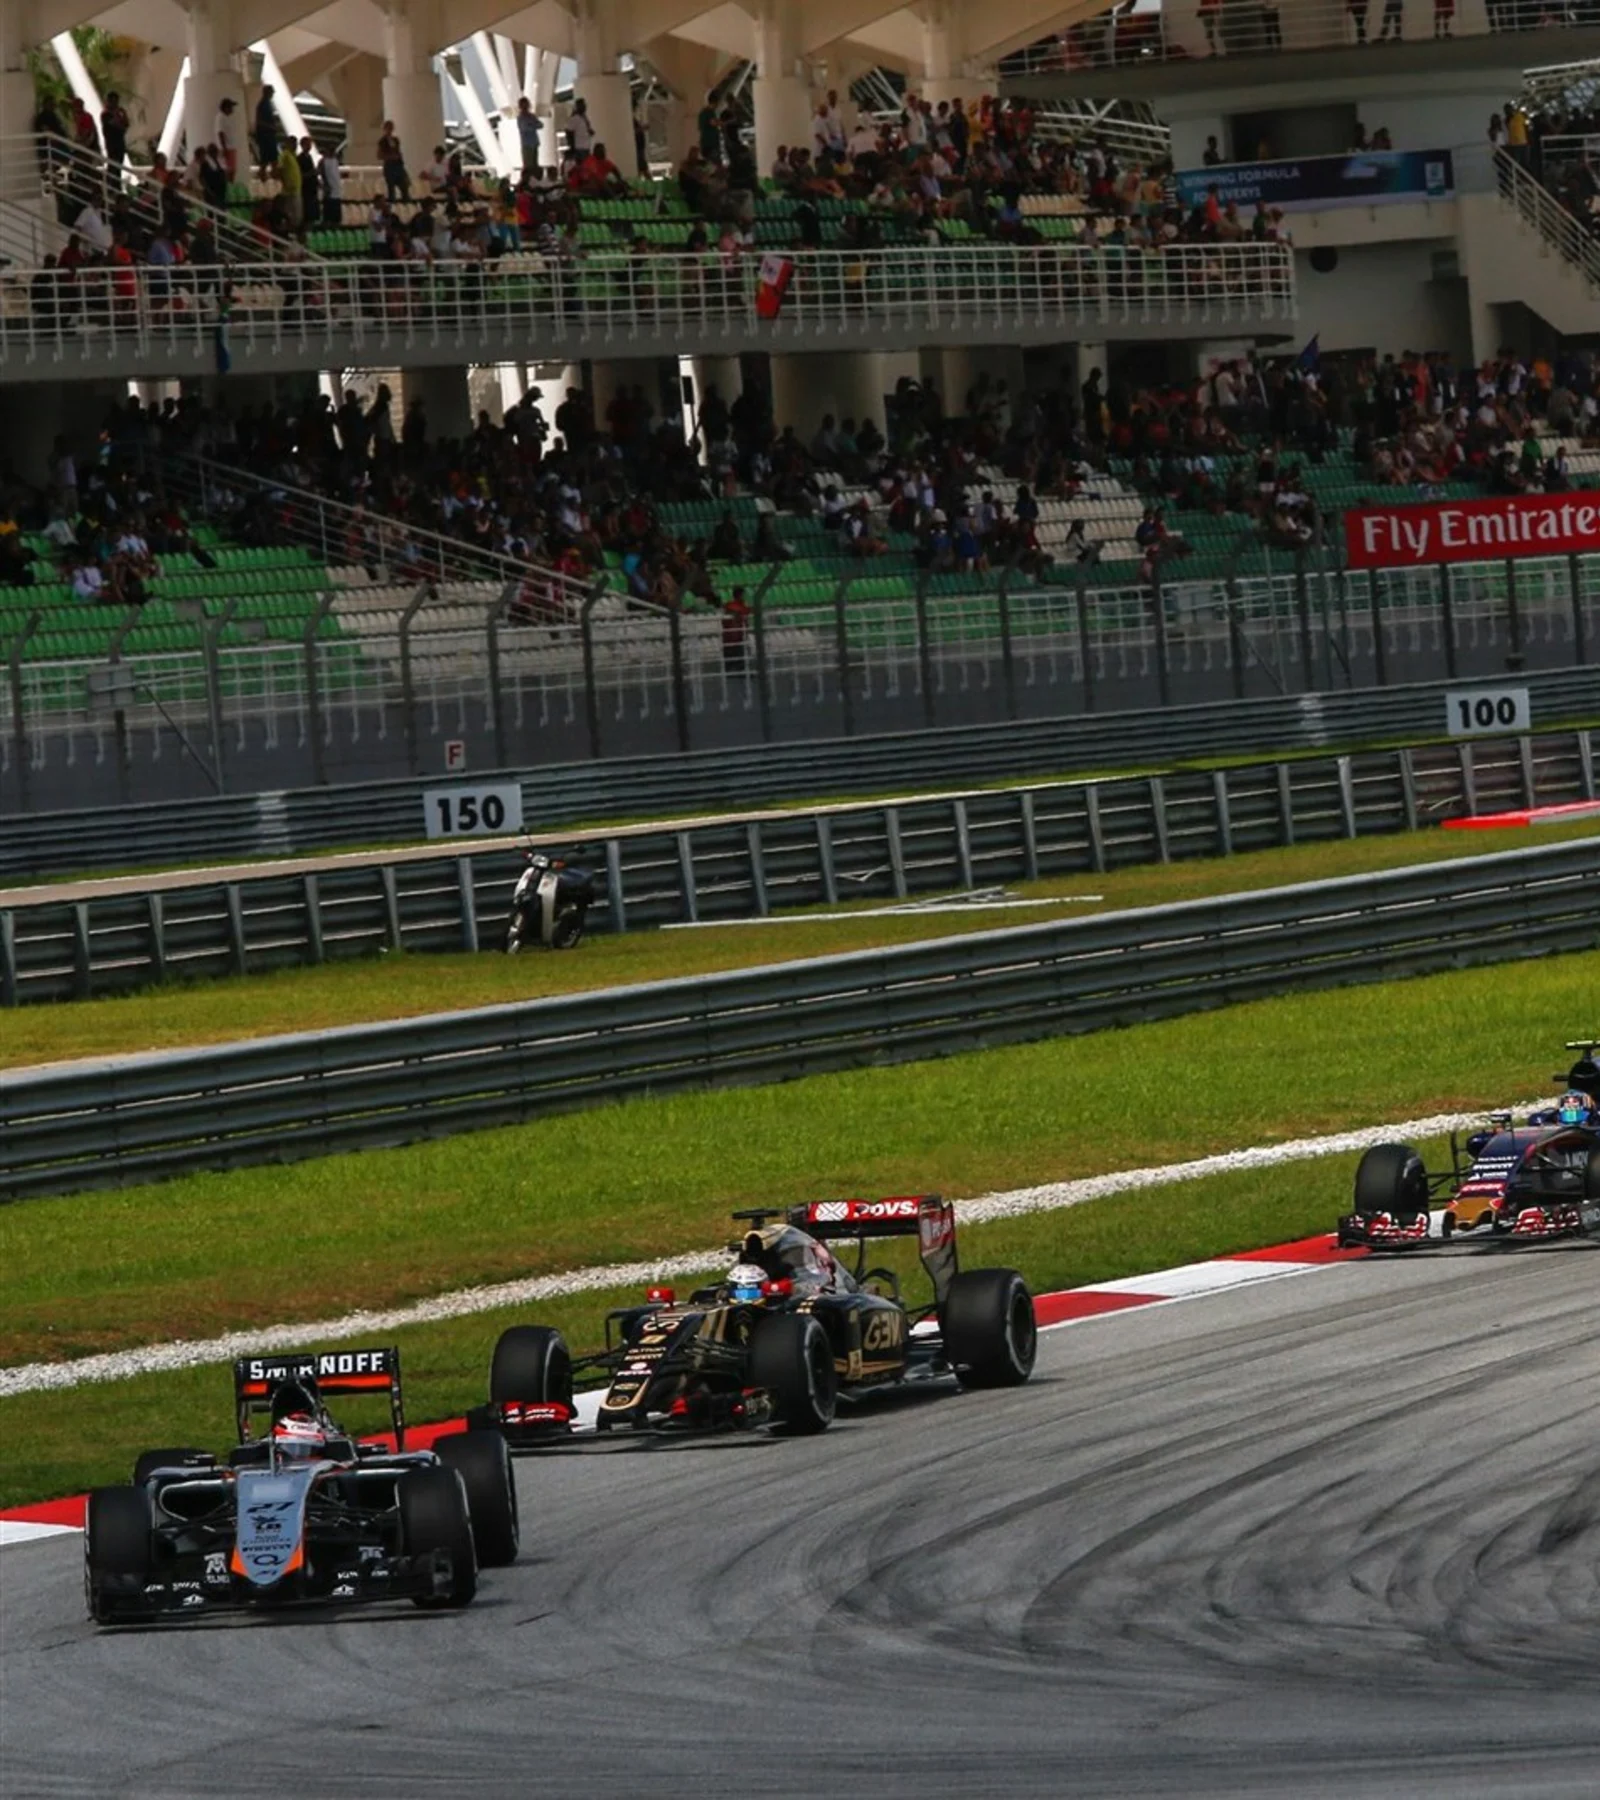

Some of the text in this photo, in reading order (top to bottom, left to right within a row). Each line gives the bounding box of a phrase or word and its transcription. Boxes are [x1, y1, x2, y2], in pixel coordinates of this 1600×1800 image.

[1238, 166, 1300, 181] FORMULA
[1362, 515, 1429, 557] Fly
[1458, 697, 1516, 729] 100
[448, 743, 462, 765] F
[437, 794, 505, 832] 150
